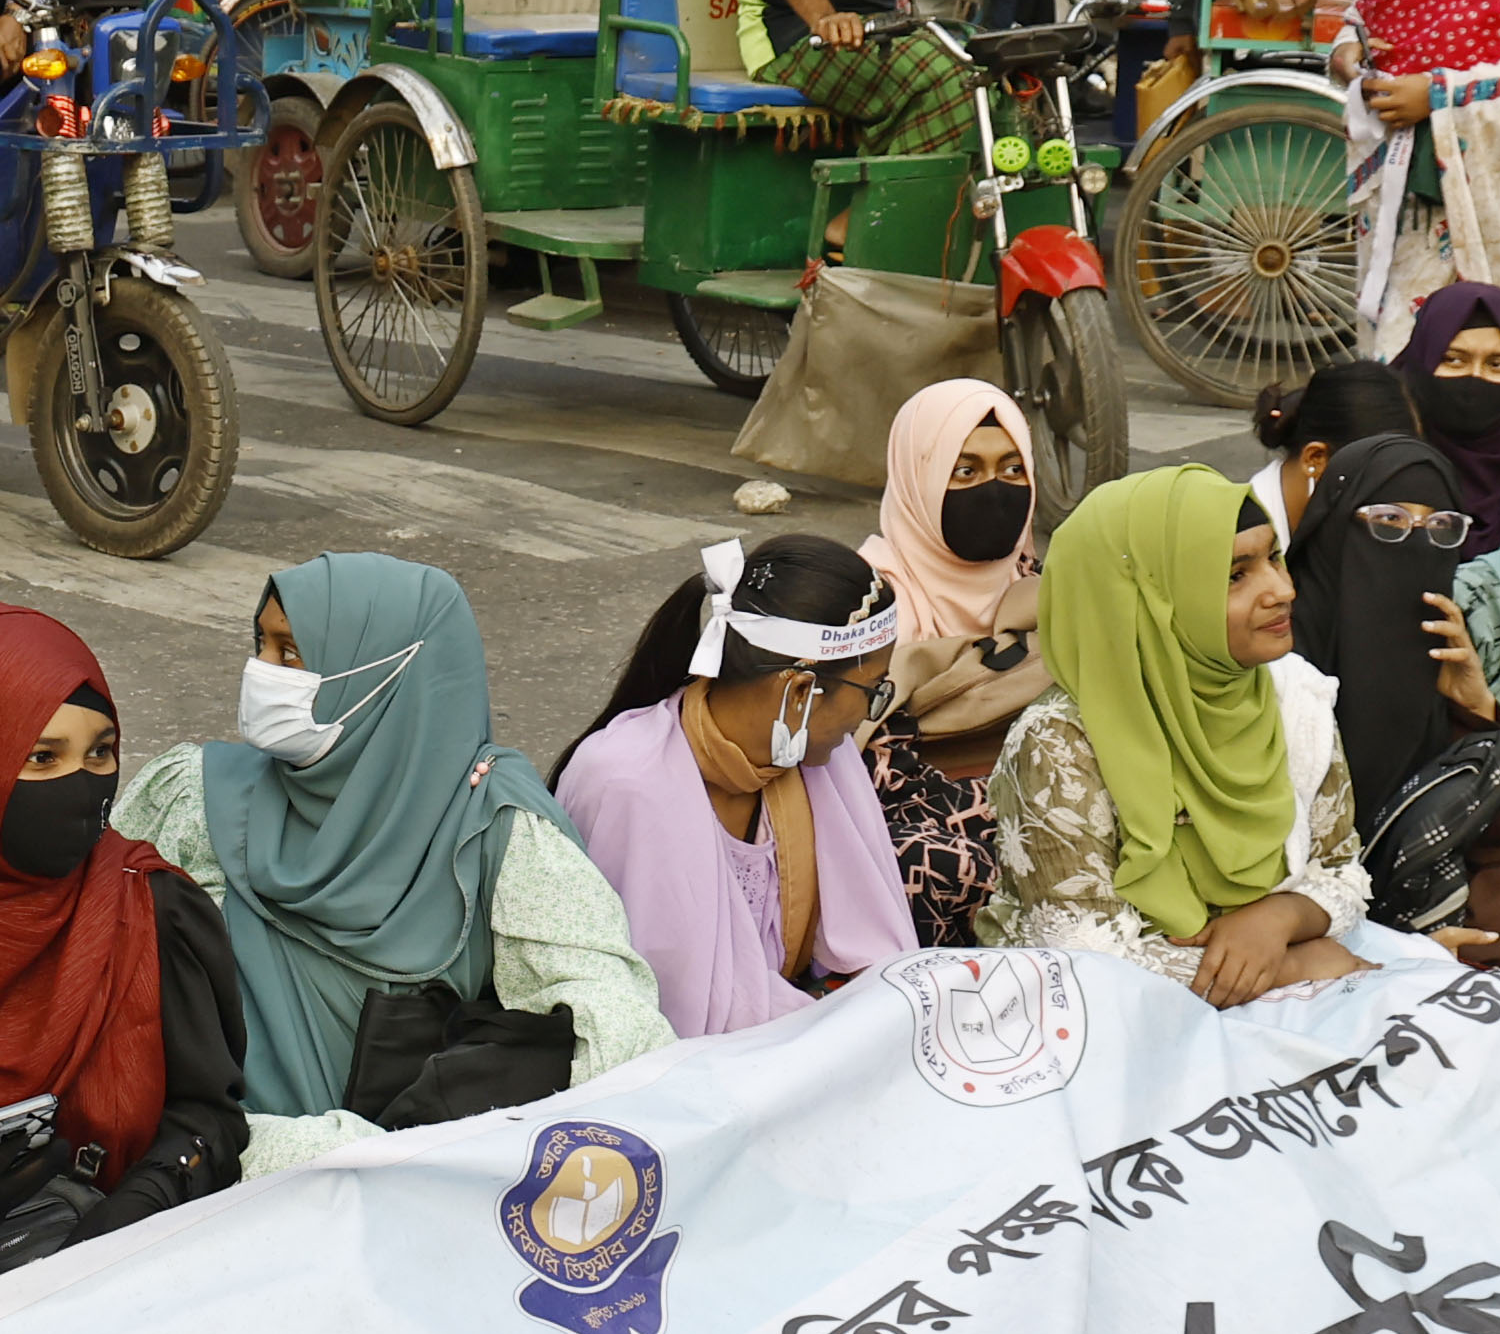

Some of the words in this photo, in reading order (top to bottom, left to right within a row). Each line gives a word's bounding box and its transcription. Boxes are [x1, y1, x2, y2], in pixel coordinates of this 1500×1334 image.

[819, 642, 854, 656] ঢাকা
[821, 626, 866, 643] Dhaka
[946, 1183, 1091, 1278] পক্ষ
[1169, 1013, 1460, 1160] অধ্যাদেশ
[507, 1201, 560, 1276] সরকারি
[625, 1162, 657, 1239] কলেজ
